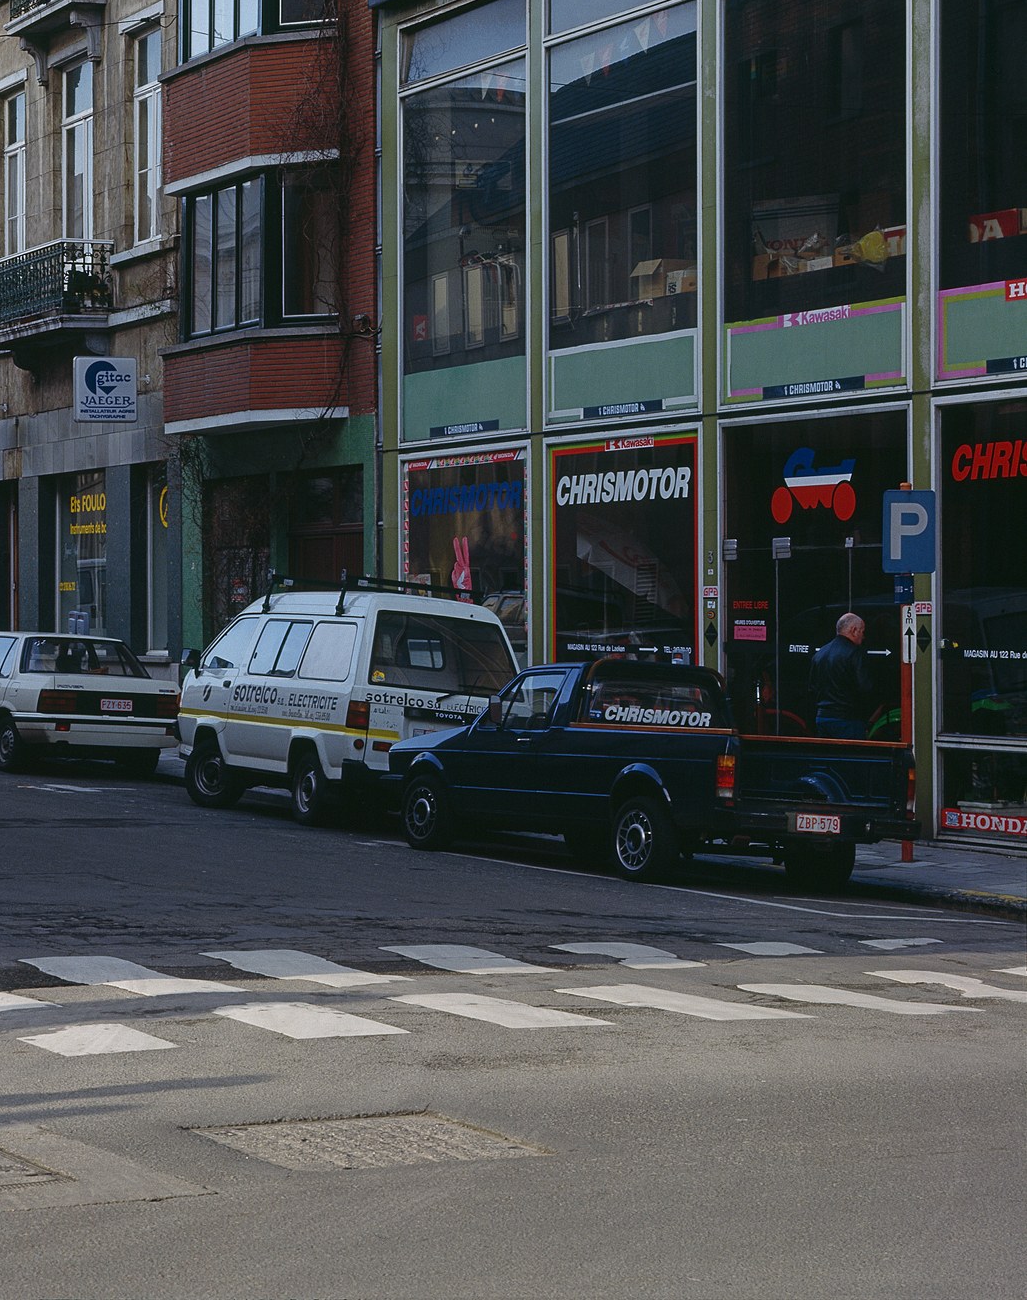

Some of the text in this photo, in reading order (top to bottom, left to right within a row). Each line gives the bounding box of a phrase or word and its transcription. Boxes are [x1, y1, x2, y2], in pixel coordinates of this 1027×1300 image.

[1008, 281, 1027, 298] H
[801, 305, 850, 325] Kawasaki
[789, 380, 833, 395] CHRISMOTOR
[85, 396, 131, 405] JAEGER
[602, 402, 639, 415] CHRISMOTOR
[447, 422, 479, 435] CHRISMOTOR
[621, 436, 654, 449] Kawasaki
[556, 466, 691, 506] CHRISMOTOR
[70, 495, 80, 512] Ets
[411, 481, 523, 517] CHRISMOTOR
[70, 523, 94, 535] Instruments
[890, 503, 928, 560] P
[789, 644, 809, 653] ENTREE
[964, 650, 988, 658] MAGASIN
[989, 650, 998, 659] AU
[999, 650, 1008, 659] 122
[1010, 650, 1021, 659] Rue
[233, 682, 278, 704] sotrelco
[288, 693, 338, 710] ELECTRICITE
[365, 692, 424, 708] sotrelco
[435, 712, 463, 720] TOYOTA
[604, 704, 712, 727] CHRISMOTOR
